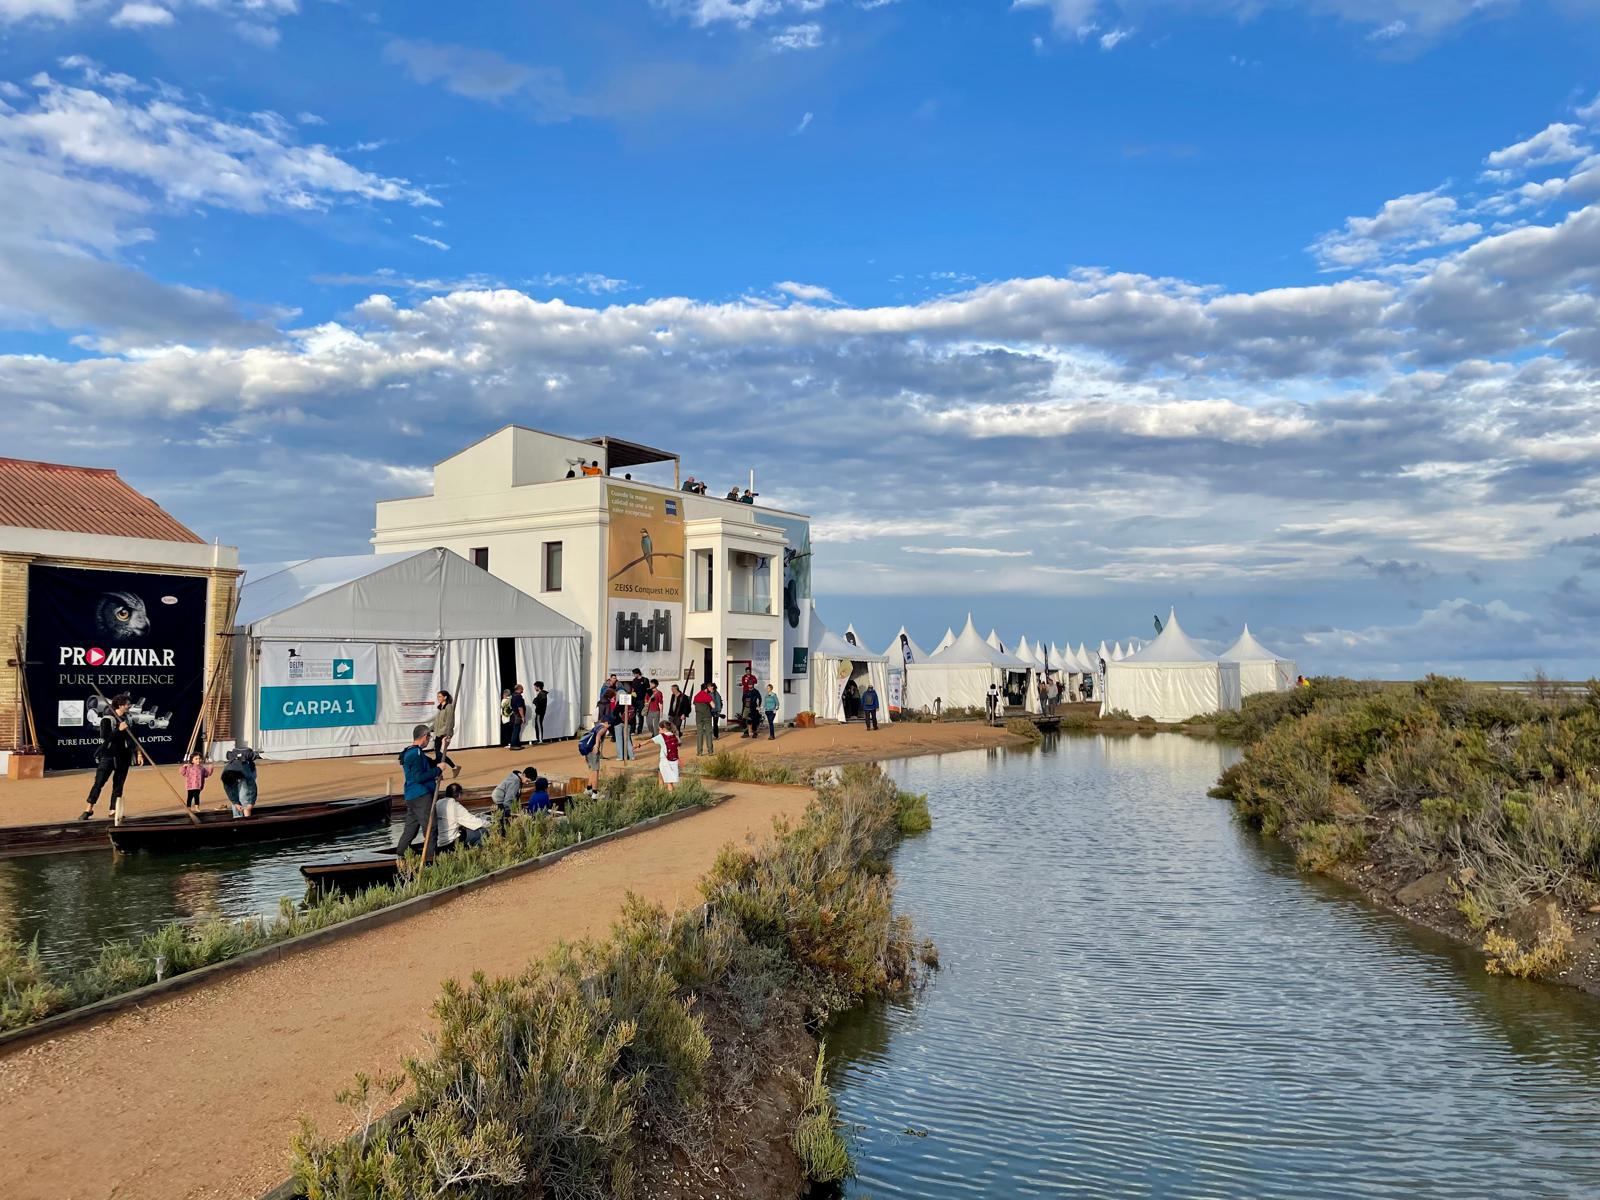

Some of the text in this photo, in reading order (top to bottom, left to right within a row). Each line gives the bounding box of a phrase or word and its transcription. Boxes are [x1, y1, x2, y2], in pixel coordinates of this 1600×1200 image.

[614, 583, 679, 596] ZEISS Conquest HDX
[59, 646, 175, 666] PROMINAR
[59, 674, 175, 685] PURE EXPERIENCE
[282, 699, 355, 716] CARPA 1
[57, 738, 78, 746] PURE
[147, 735, 172, 743] OPTICS
